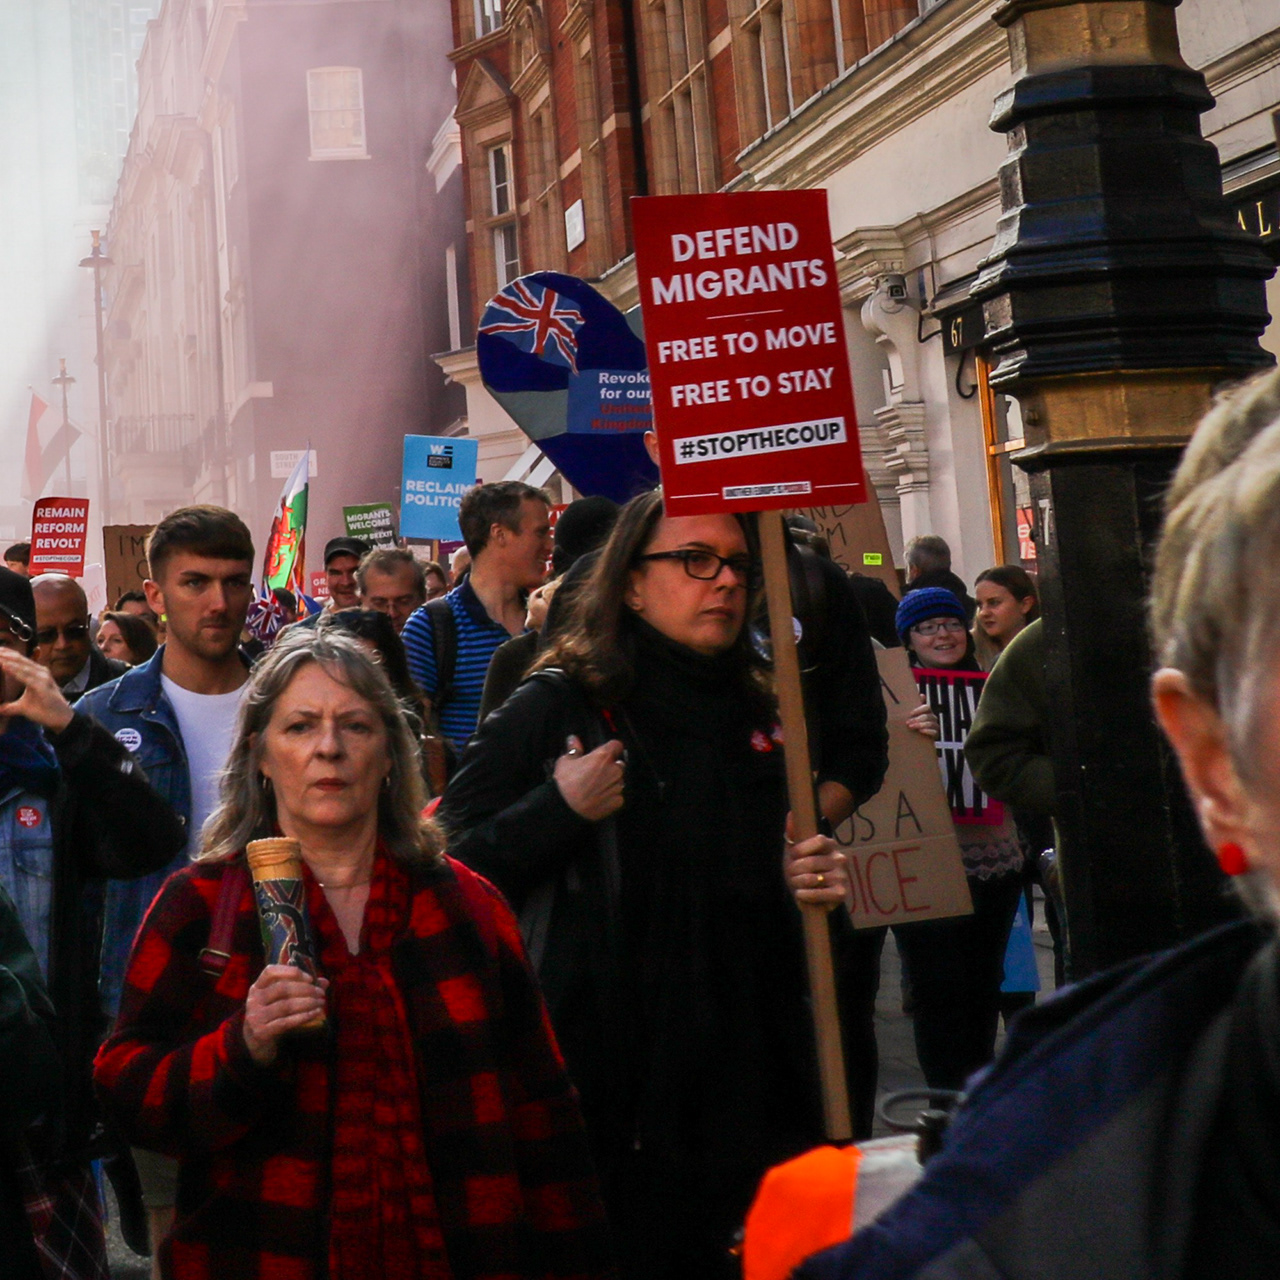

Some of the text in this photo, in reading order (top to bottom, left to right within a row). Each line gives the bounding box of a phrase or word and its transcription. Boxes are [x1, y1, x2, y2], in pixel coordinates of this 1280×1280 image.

[671, 222, 800, 263] DEFEND
[651, 258, 828, 305] MIGRANTS
[657, 321, 837, 364] FREE TO MOVE
[600, 387, 622, 399] for
[671, 367, 835, 408] FREE TO STAY
[680, 420, 841, 459] #STOPTHECOUP
[406, 480, 472, 495] RECLAIM
[405, 493, 462, 508] POLITIC
[36, 507, 85, 518] REMAIN
[346, 509, 391, 522] MIGRANTS
[35, 523, 84, 533] REFORM
[348, 518, 391, 530] WELCOME
[36, 538, 81, 548] REVOLT
[896, 790, 923, 838] A
[848, 846, 931, 916] ICE
